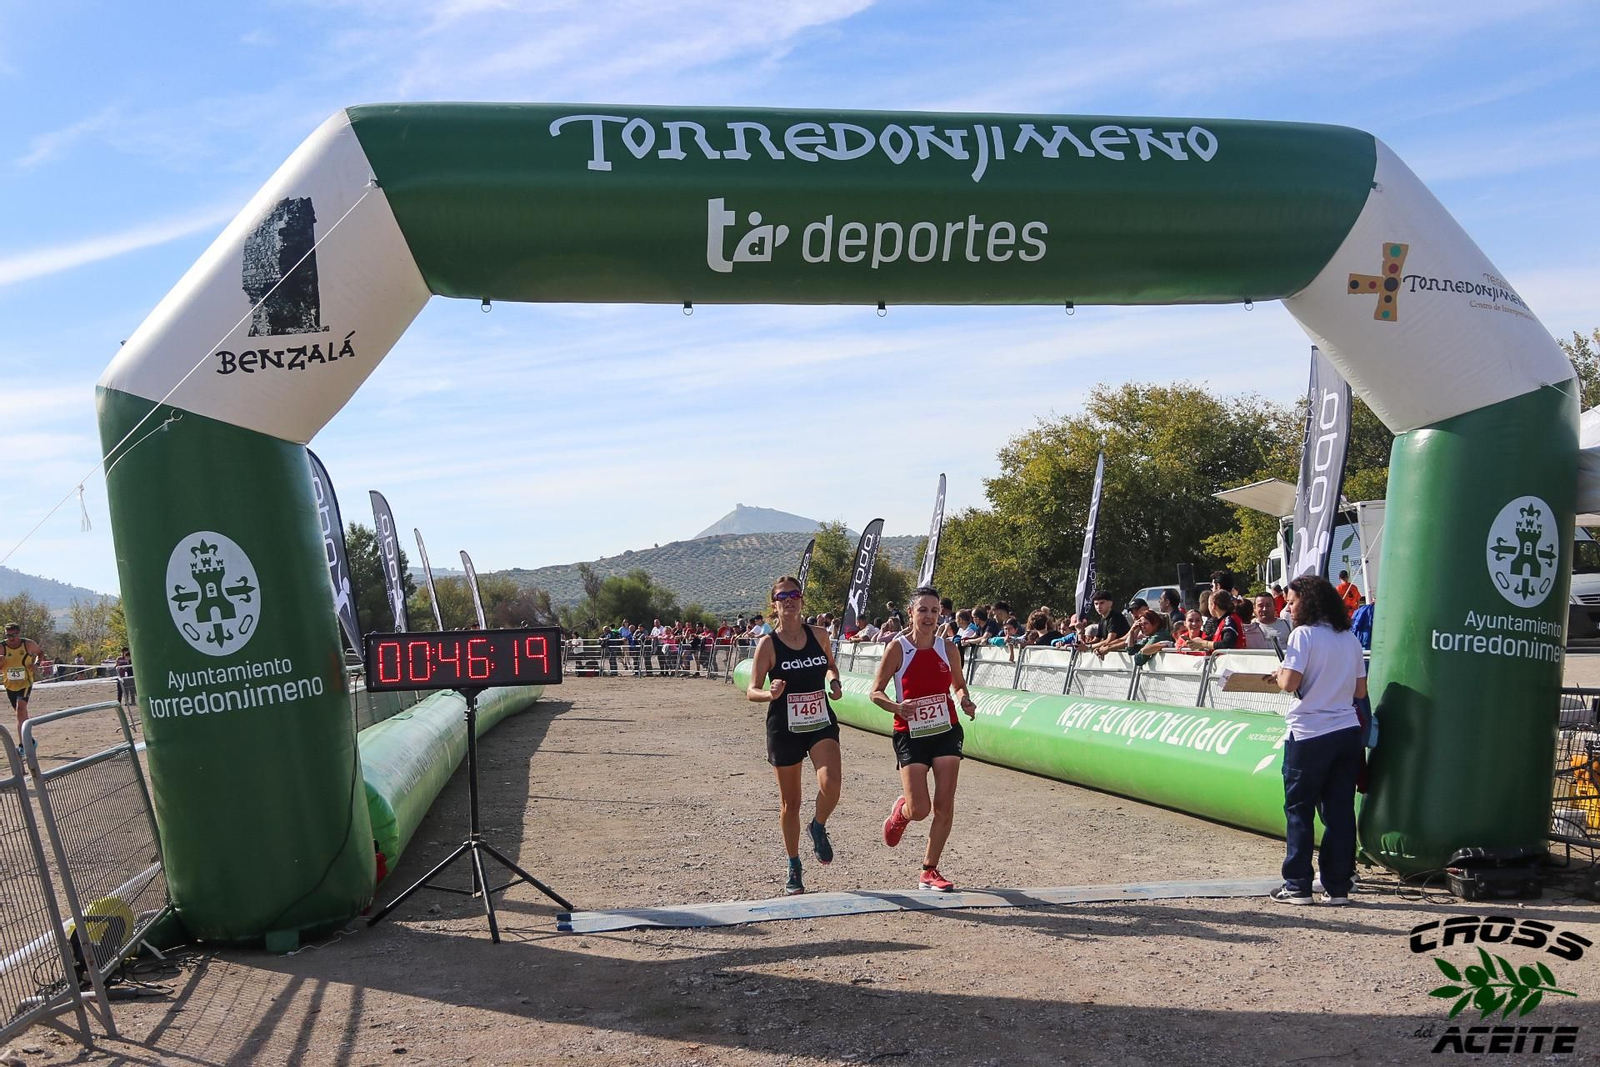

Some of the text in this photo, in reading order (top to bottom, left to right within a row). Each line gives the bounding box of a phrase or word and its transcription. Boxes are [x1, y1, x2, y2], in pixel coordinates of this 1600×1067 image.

[549, 114, 1219, 183] TORREDONJIMENO
[802, 214, 1049, 269] deportes
[215, 330, 356, 375] BENZALÁ
[1464, 610, 1562, 638] Ayuntamiento
[378, 636, 548, 683] 00:46:19
[781, 655, 828, 670] adidas
[1431, 629, 1562, 663] torredonjime
[167, 657, 293, 692] Ayuntamiento
[148, 675, 324, 720] torredonjimeno
[791, 700, 823, 717] 1461
[913, 704, 944, 722] 1521
[1056, 702, 1250, 755] DIPUTACIÓN DE JAÉN
